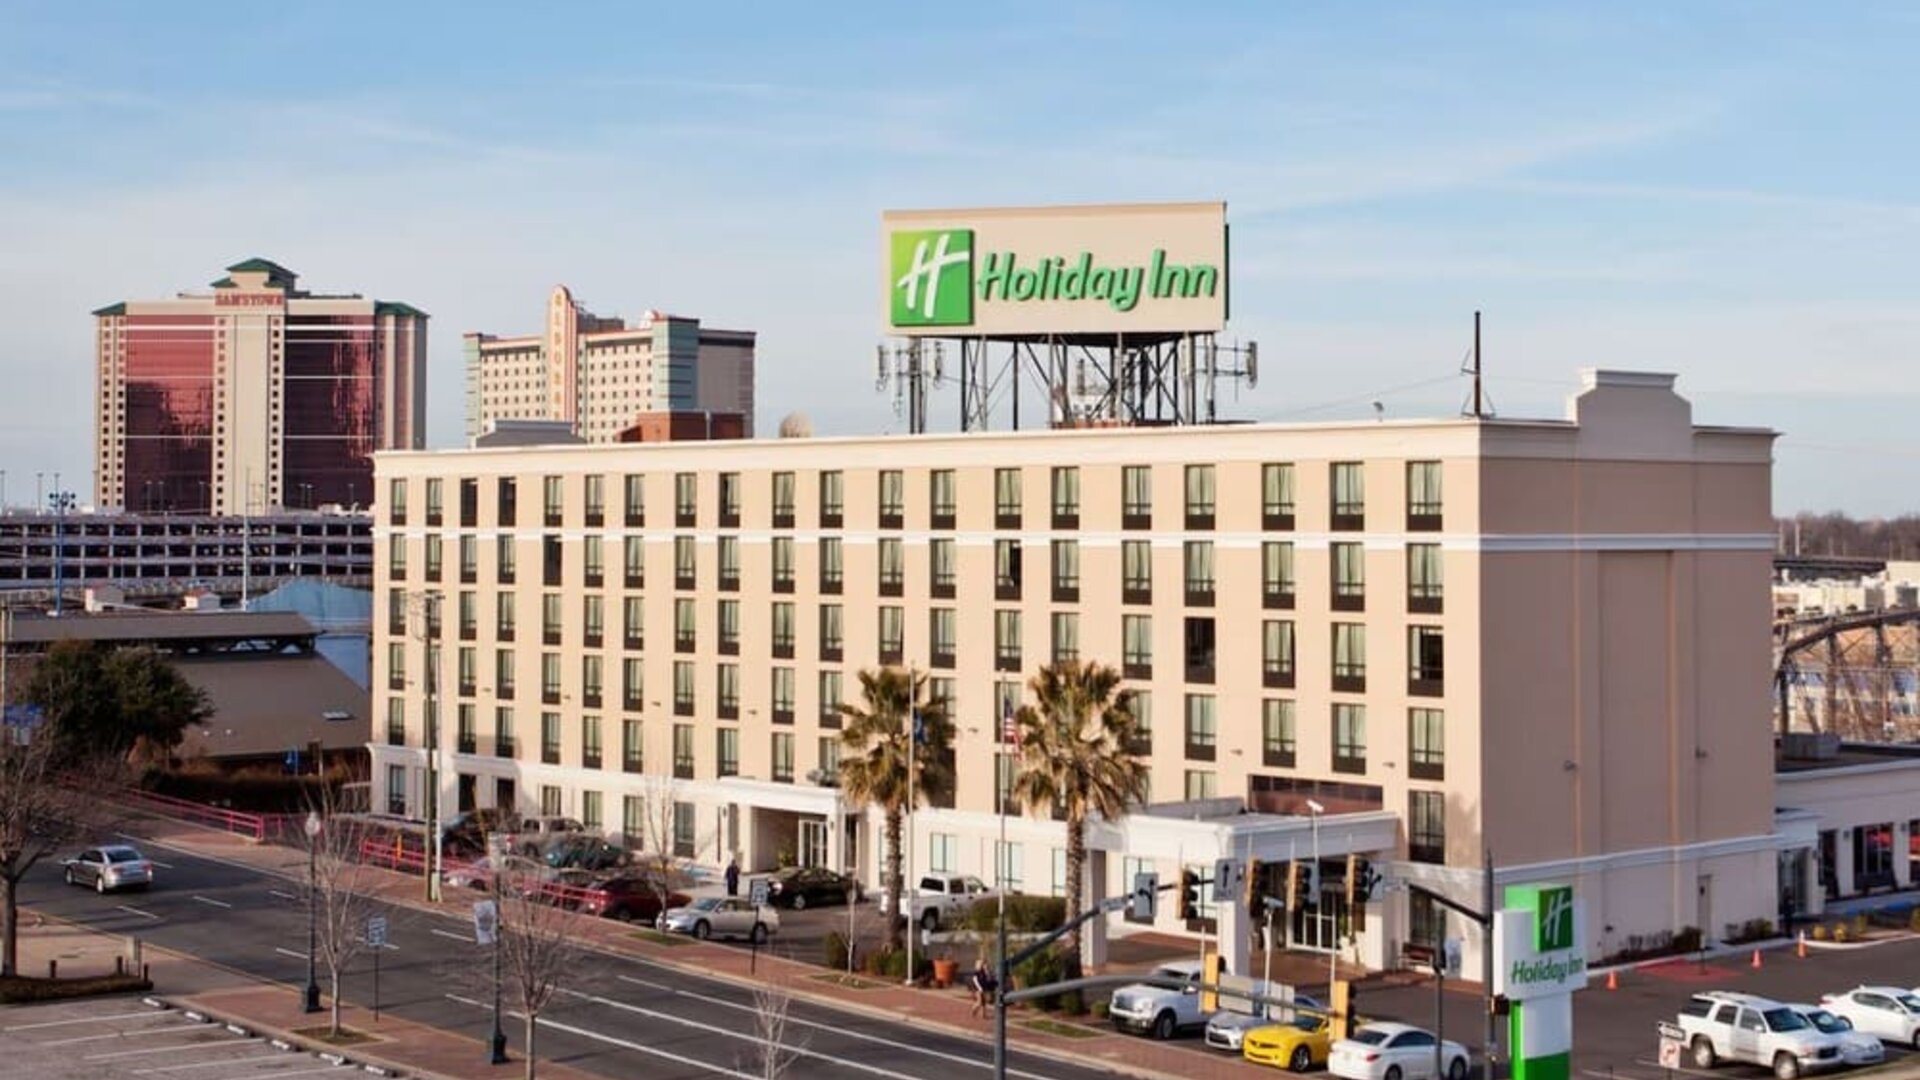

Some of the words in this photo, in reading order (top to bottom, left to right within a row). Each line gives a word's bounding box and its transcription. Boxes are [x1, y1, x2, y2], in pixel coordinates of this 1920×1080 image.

[977, 250, 1144, 312] Holiday
[1149, 248, 1217, 299] Inn
[1511, 956, 1568, 984] Holiday
[1568, 952, 1583, 976] Inn
